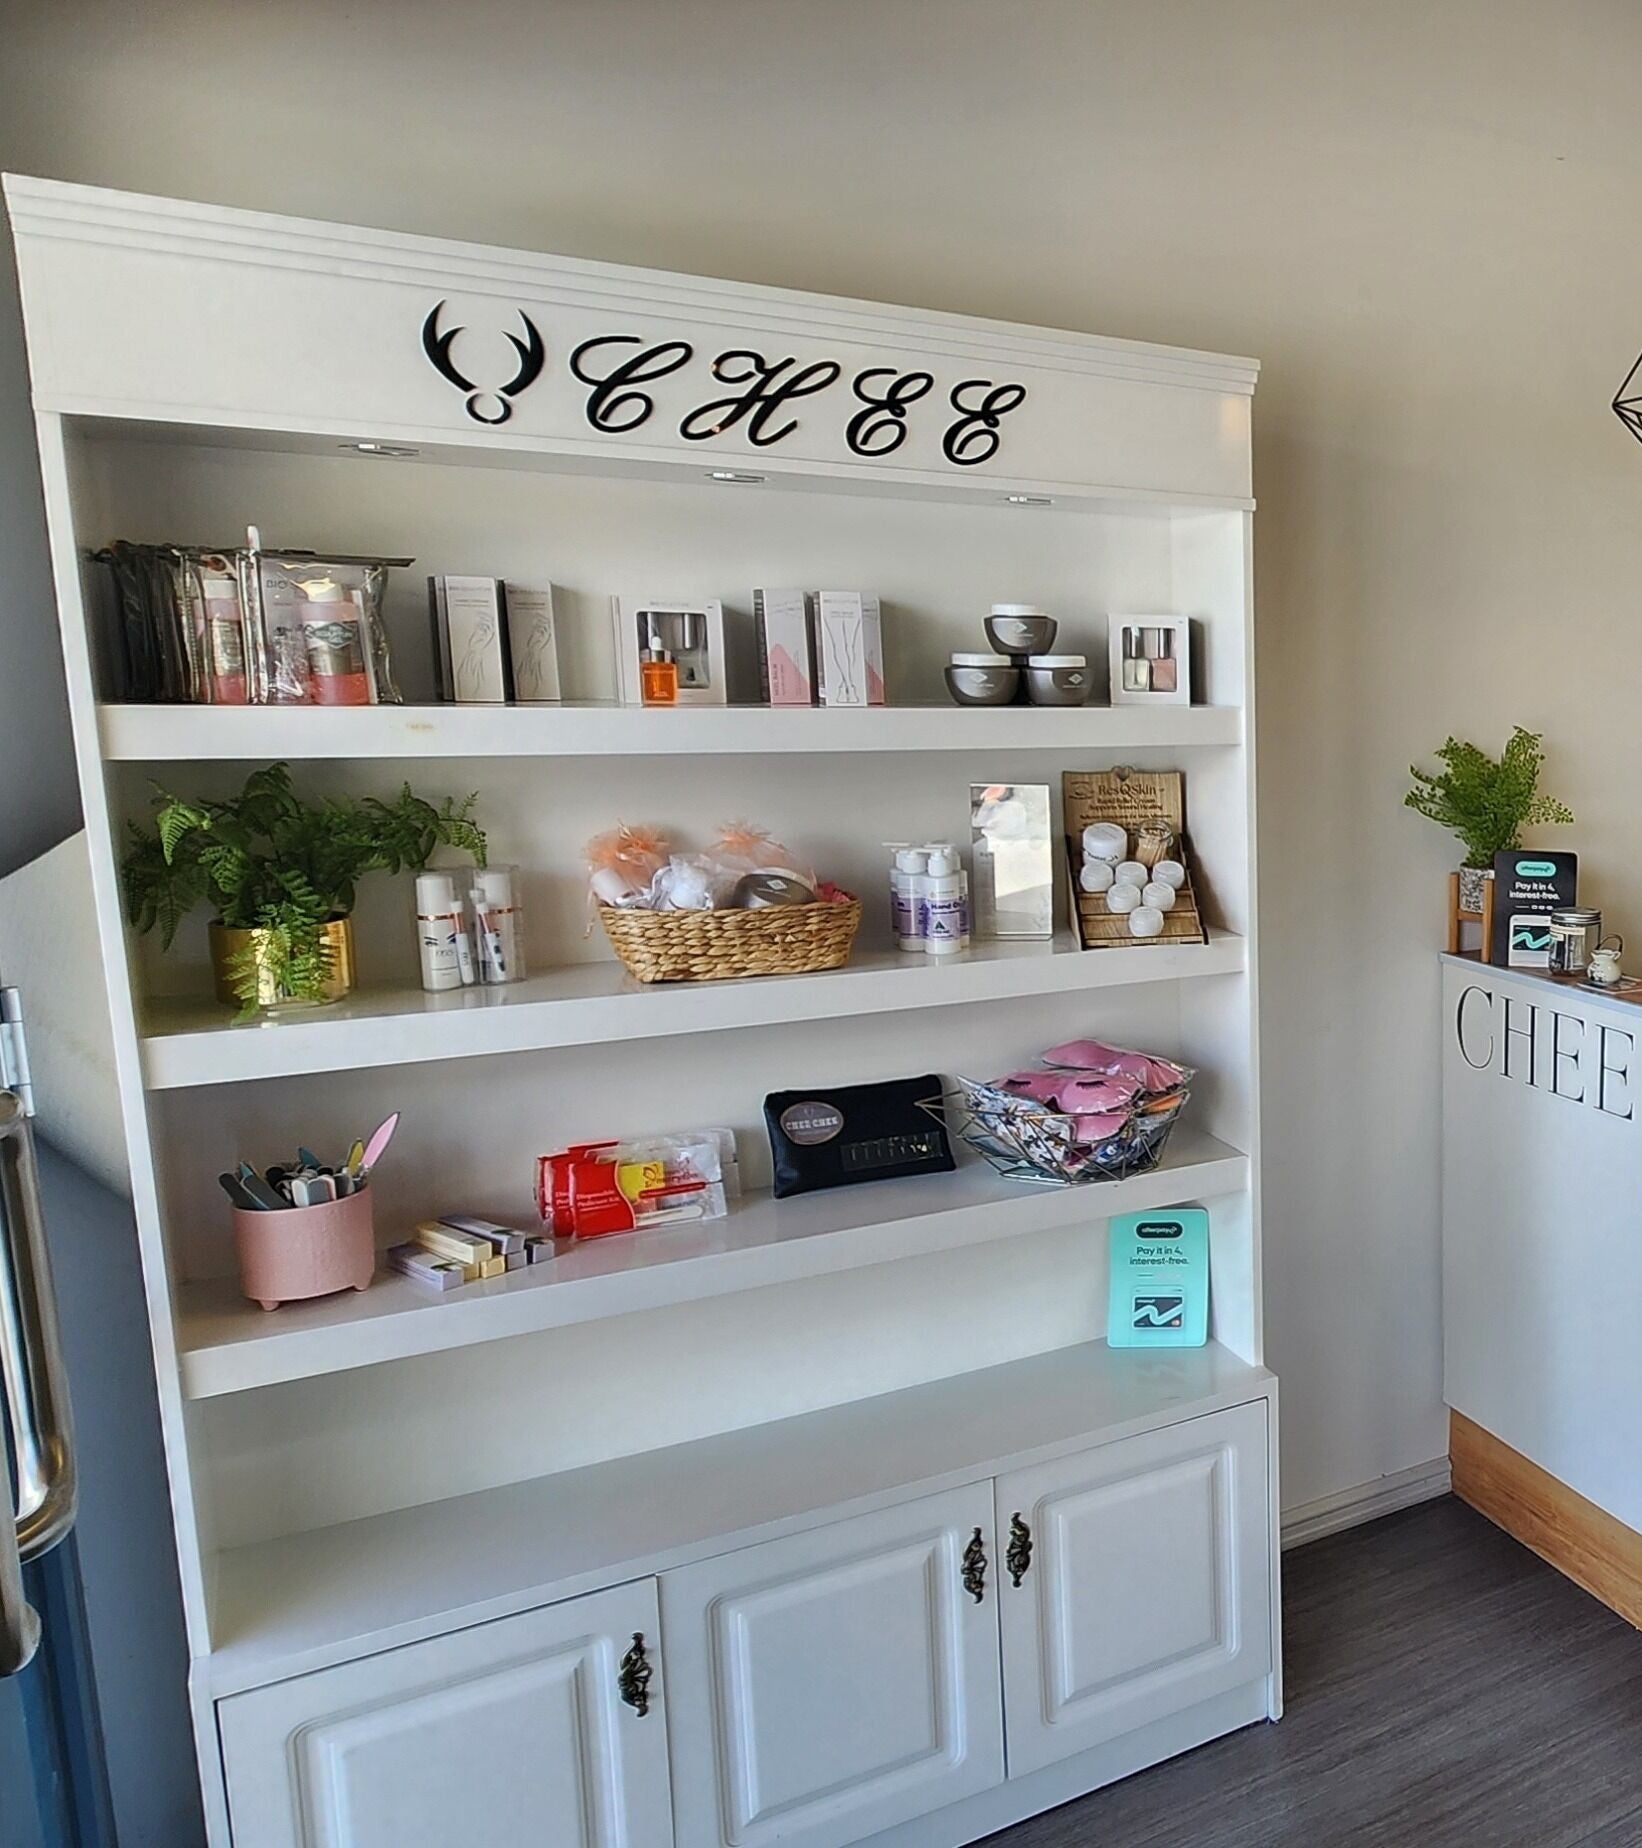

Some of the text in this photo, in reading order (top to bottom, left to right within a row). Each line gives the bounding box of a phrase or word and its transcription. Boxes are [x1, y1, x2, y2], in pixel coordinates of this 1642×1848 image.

[569, 335, 1027, 467] CHEE
[1456, 984, 1635, 1121] CHEE
[1129, 1256, 1190, 1266] interest-free.
[1136, 1246, 1155, 1256] Pay
[1156, 1246, 1163, 1255] it
[1164, 1246, 1173, 1255] in
